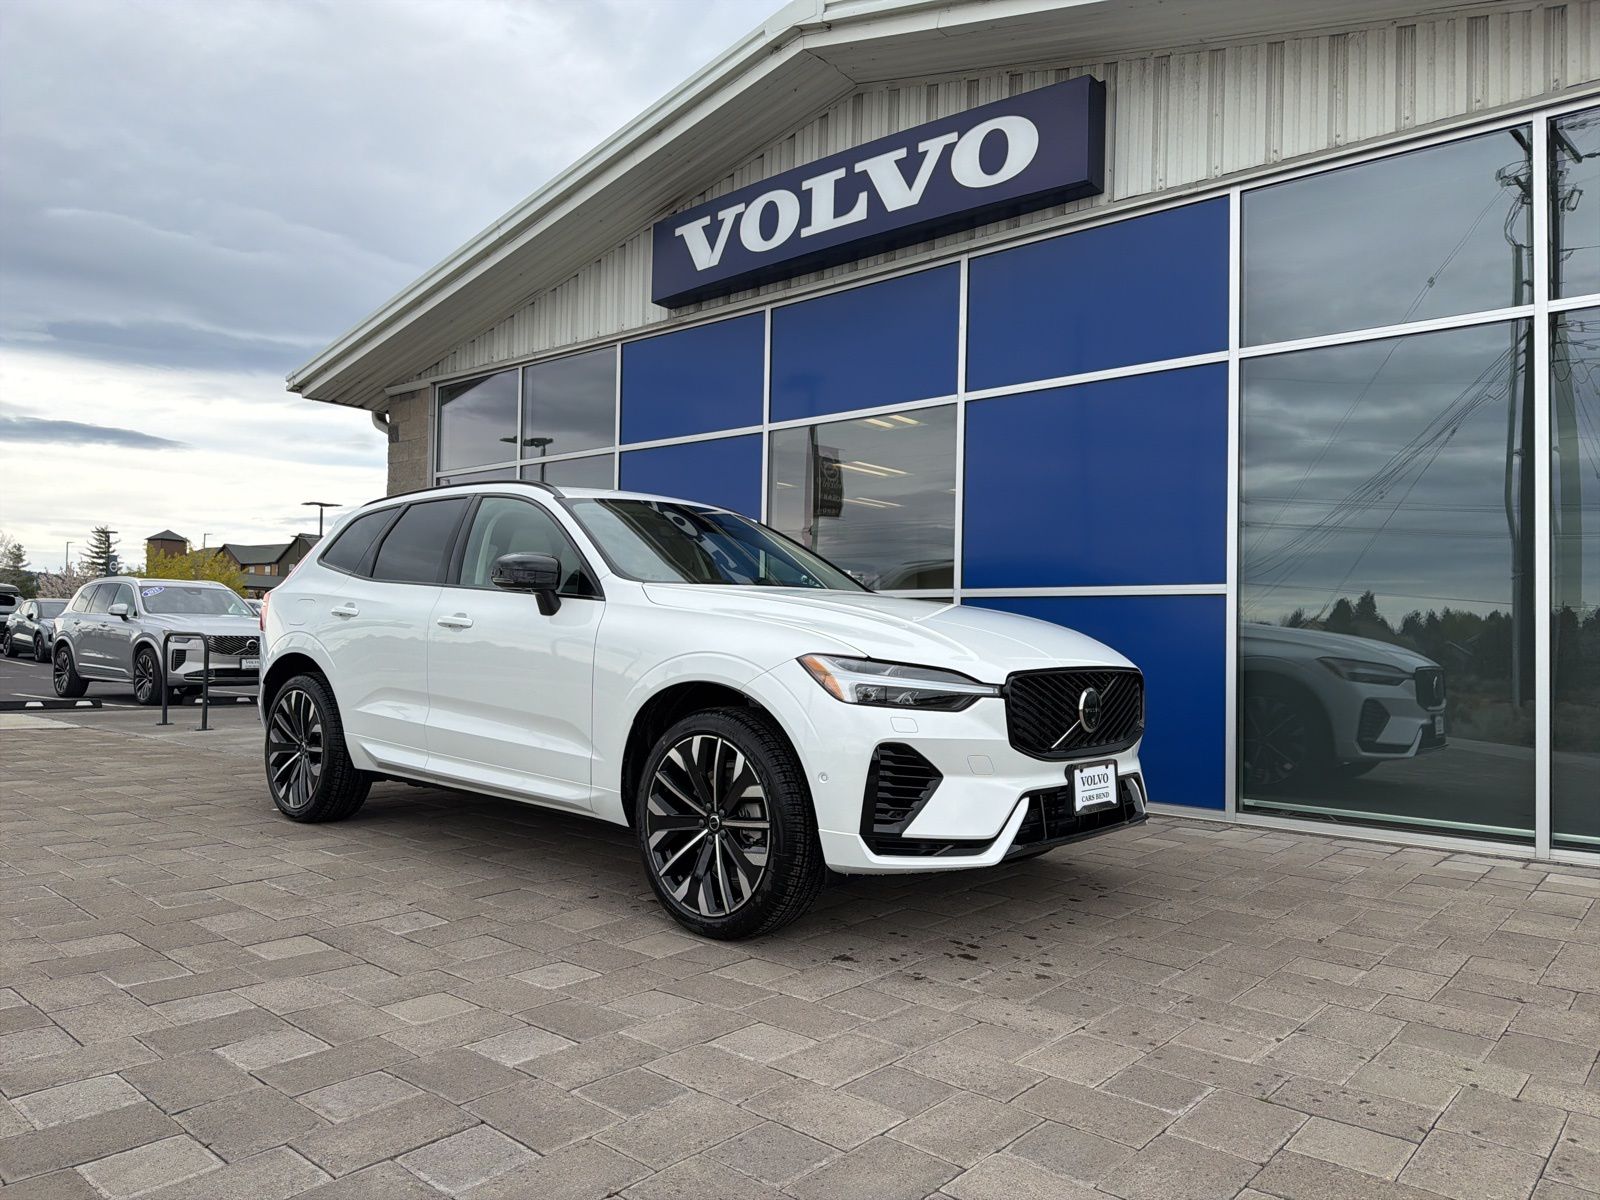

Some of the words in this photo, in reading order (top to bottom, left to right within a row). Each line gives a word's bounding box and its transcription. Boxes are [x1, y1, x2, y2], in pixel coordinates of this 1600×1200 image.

[675, 115, 1039, 271] VOLVO
[1080, 773, 1109, 787] VOLVO
[1081, 794, 1095, 803] CARS
[1095, 791, 1110, 800] BEND
